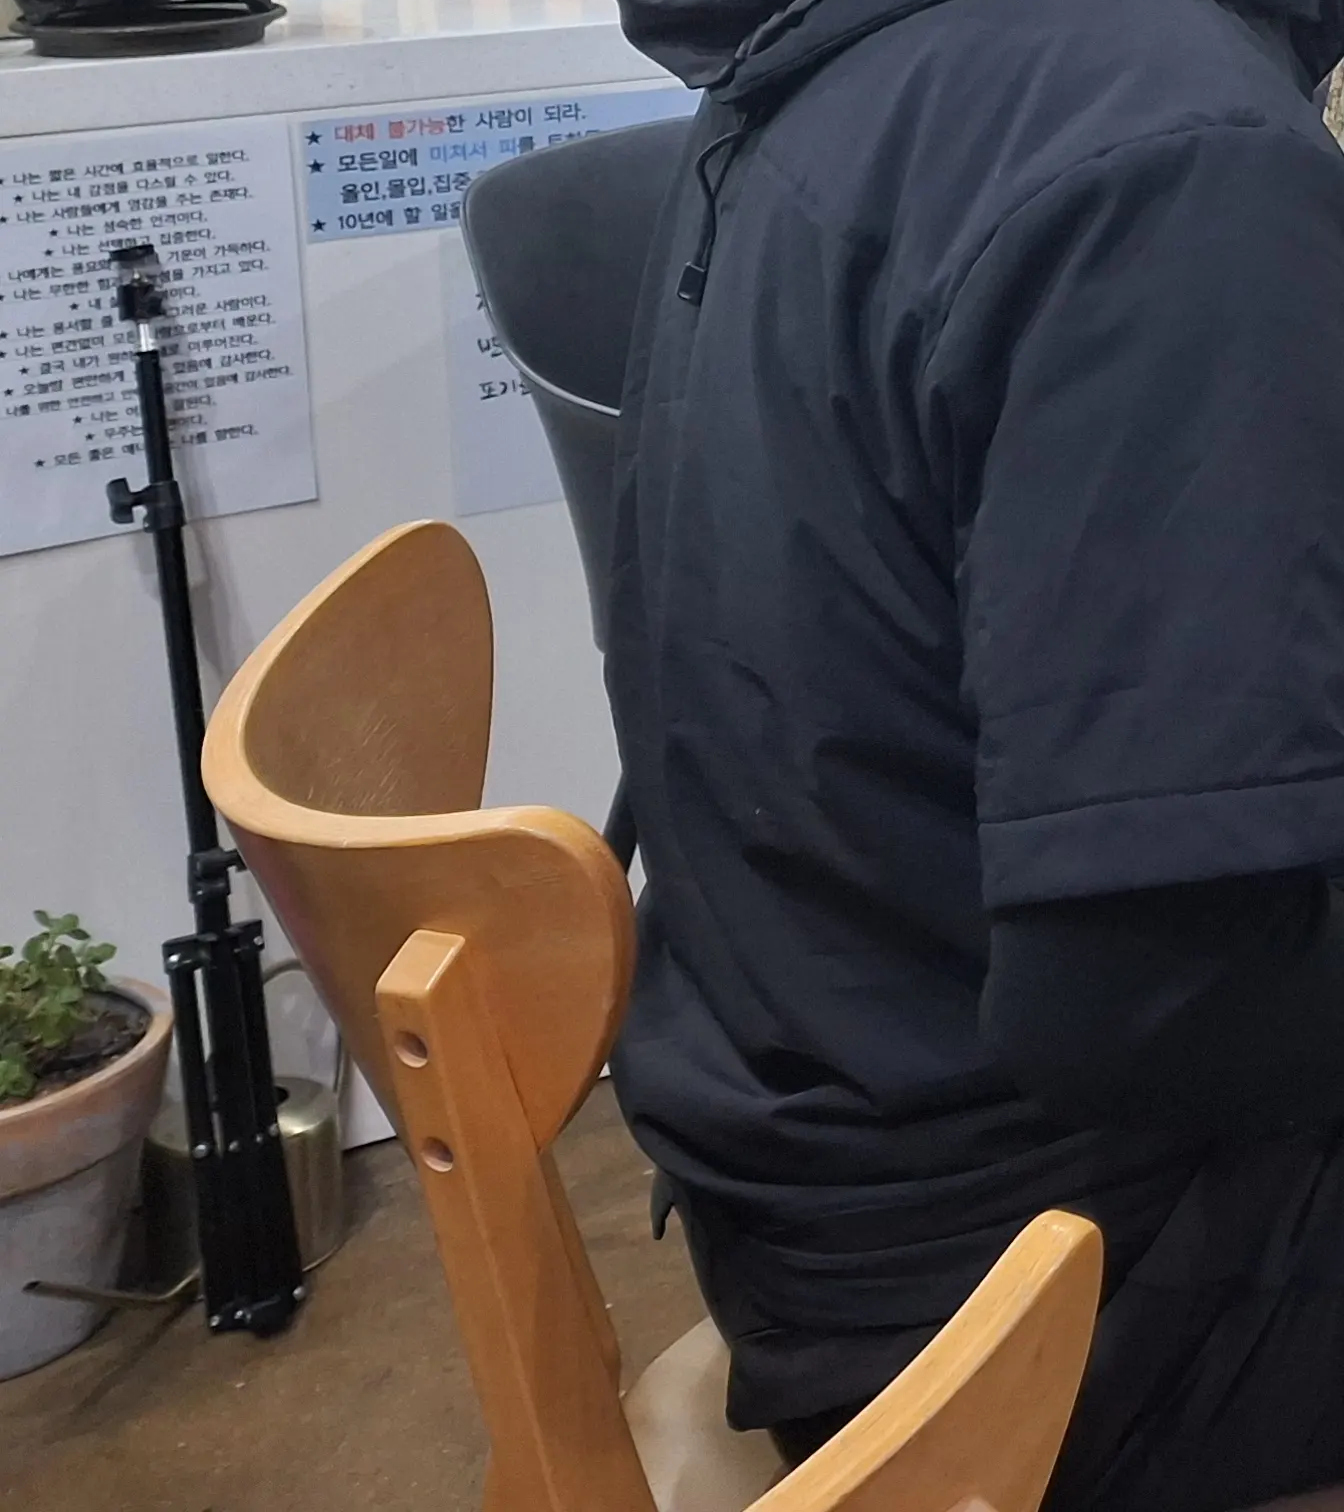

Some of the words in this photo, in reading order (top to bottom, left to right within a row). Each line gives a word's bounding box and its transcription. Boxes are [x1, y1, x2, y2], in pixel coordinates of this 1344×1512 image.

[334, 121, 375, 143] 대체
[475, 106, 533, 129] 사람이
[13, 171, 42, 186] 나는
[84, 162, 125, 178] 시간에
[32, 188, 60, 203] 나는
[67, 186, 81, 199] 내
[184, 173, 199, 186] 수
[17, 209, 45, 224] 나는
[175, 191, 203, 206] 주는
[338, 209, 394, 231] 10년에
[403, 206, 422, 225] 할
[67, 223, 95, 238] 나는
[62, 242, 91, 257] 나는
[13, 286, 42, 301] 나는
[16, 324, 45, 339] 나는
[15, 343, 44, 357] 나는
[90, 409, 119, 424] 나는
